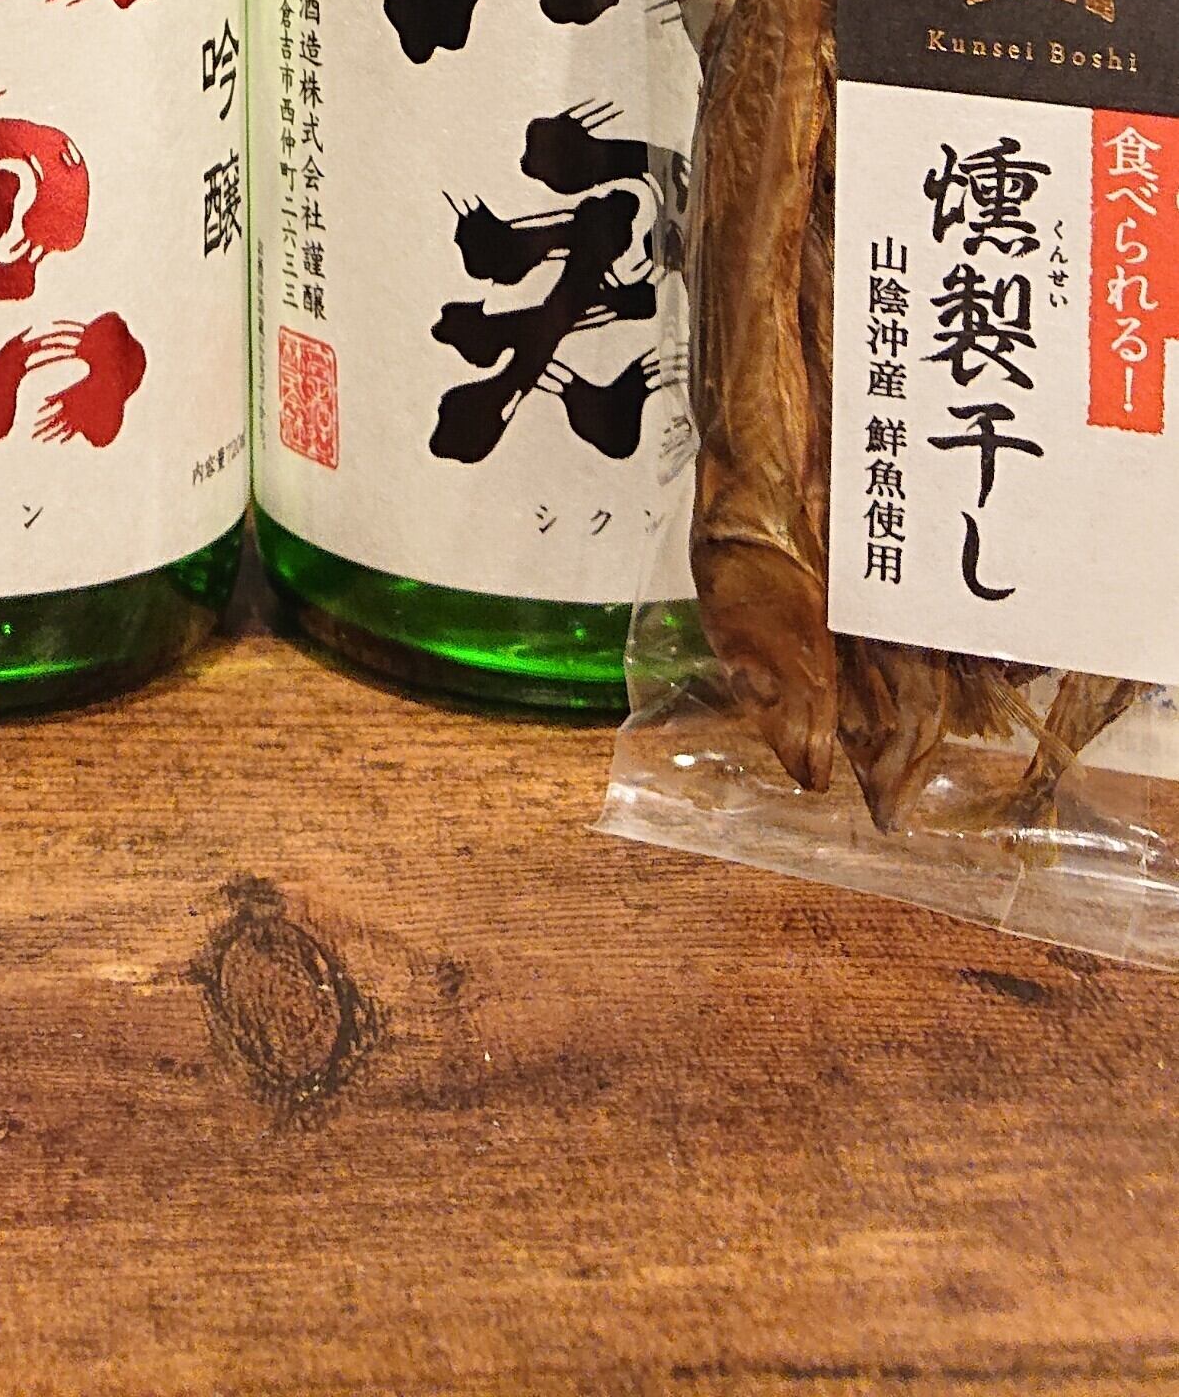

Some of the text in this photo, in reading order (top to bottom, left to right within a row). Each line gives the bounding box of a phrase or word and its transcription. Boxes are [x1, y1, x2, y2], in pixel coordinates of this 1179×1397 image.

[927, 29, 1139, 74] Kunsei Boshi
[919, 136, 1052, 602] 燻製干し
[1048, 220, 1070, 308] くんせい
[863, 236, 911, 585] 山陰沖産 鮮魚使用
